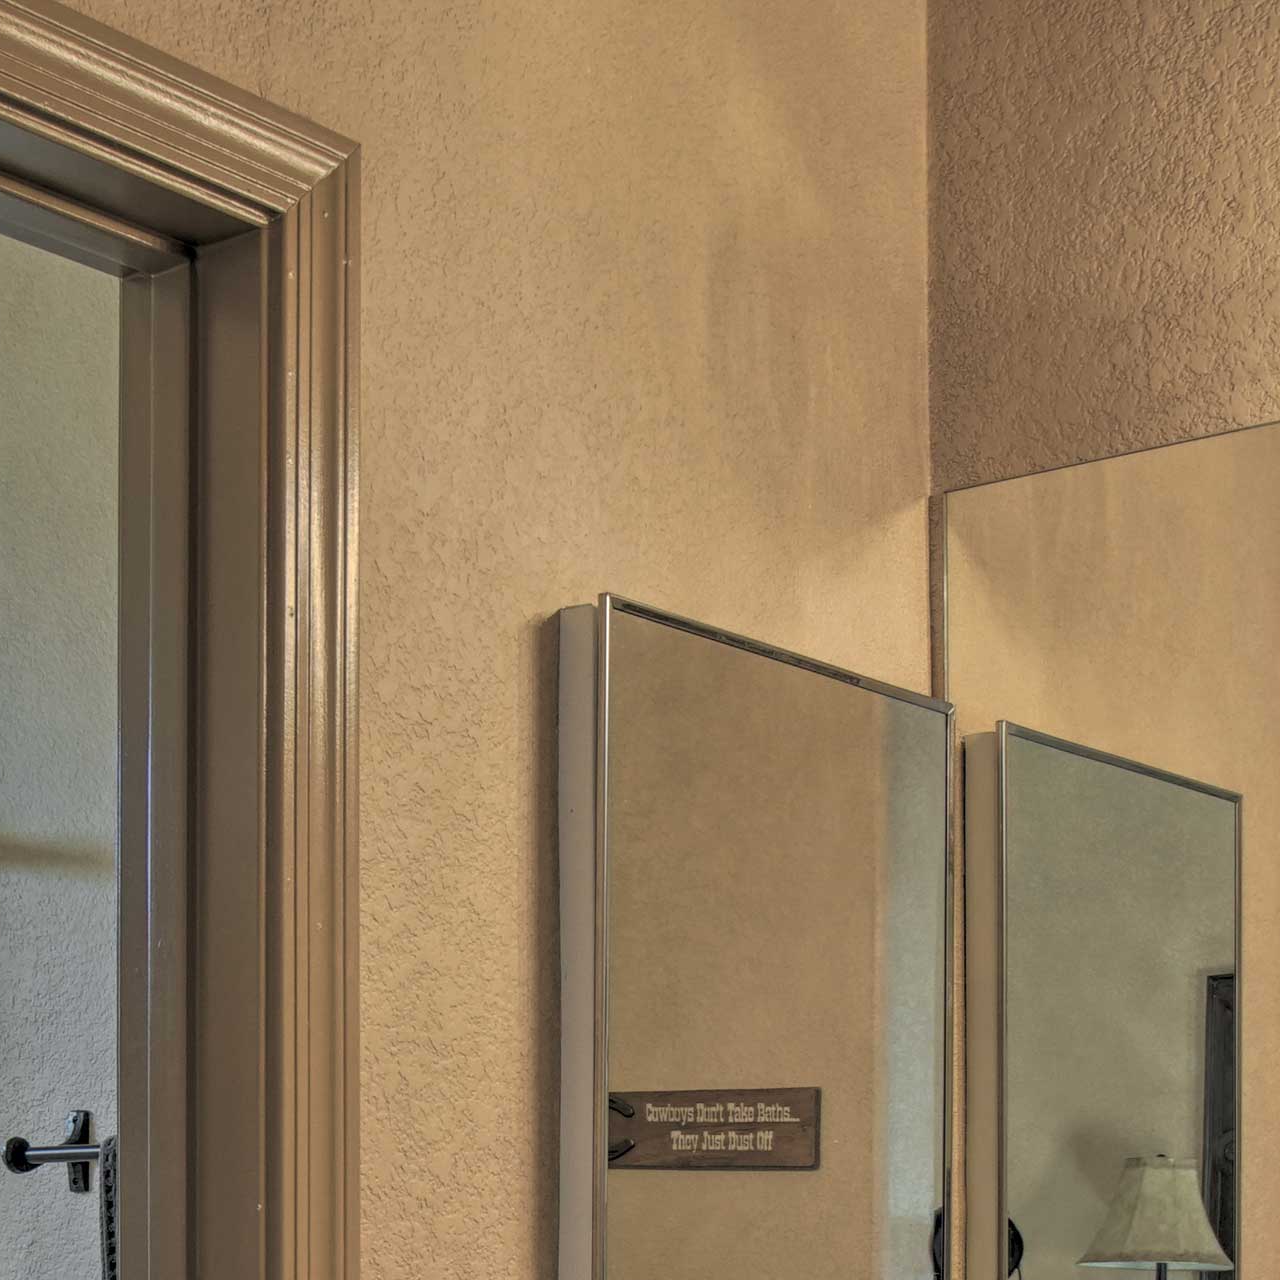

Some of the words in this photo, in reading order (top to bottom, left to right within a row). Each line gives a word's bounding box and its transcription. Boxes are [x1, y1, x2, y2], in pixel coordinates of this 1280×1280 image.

[646, 1103, 694, 1126] Cowboys
[696, 1102, 725, 1123] Don't
[727, 1102, 754, 1122] Take
[670, 1131, 698, 1153] They
[702, 1131, 725, 1151] Just
[728, 1131, 754, 1151] Dust
[757, 1131, 774, 1151] Off
